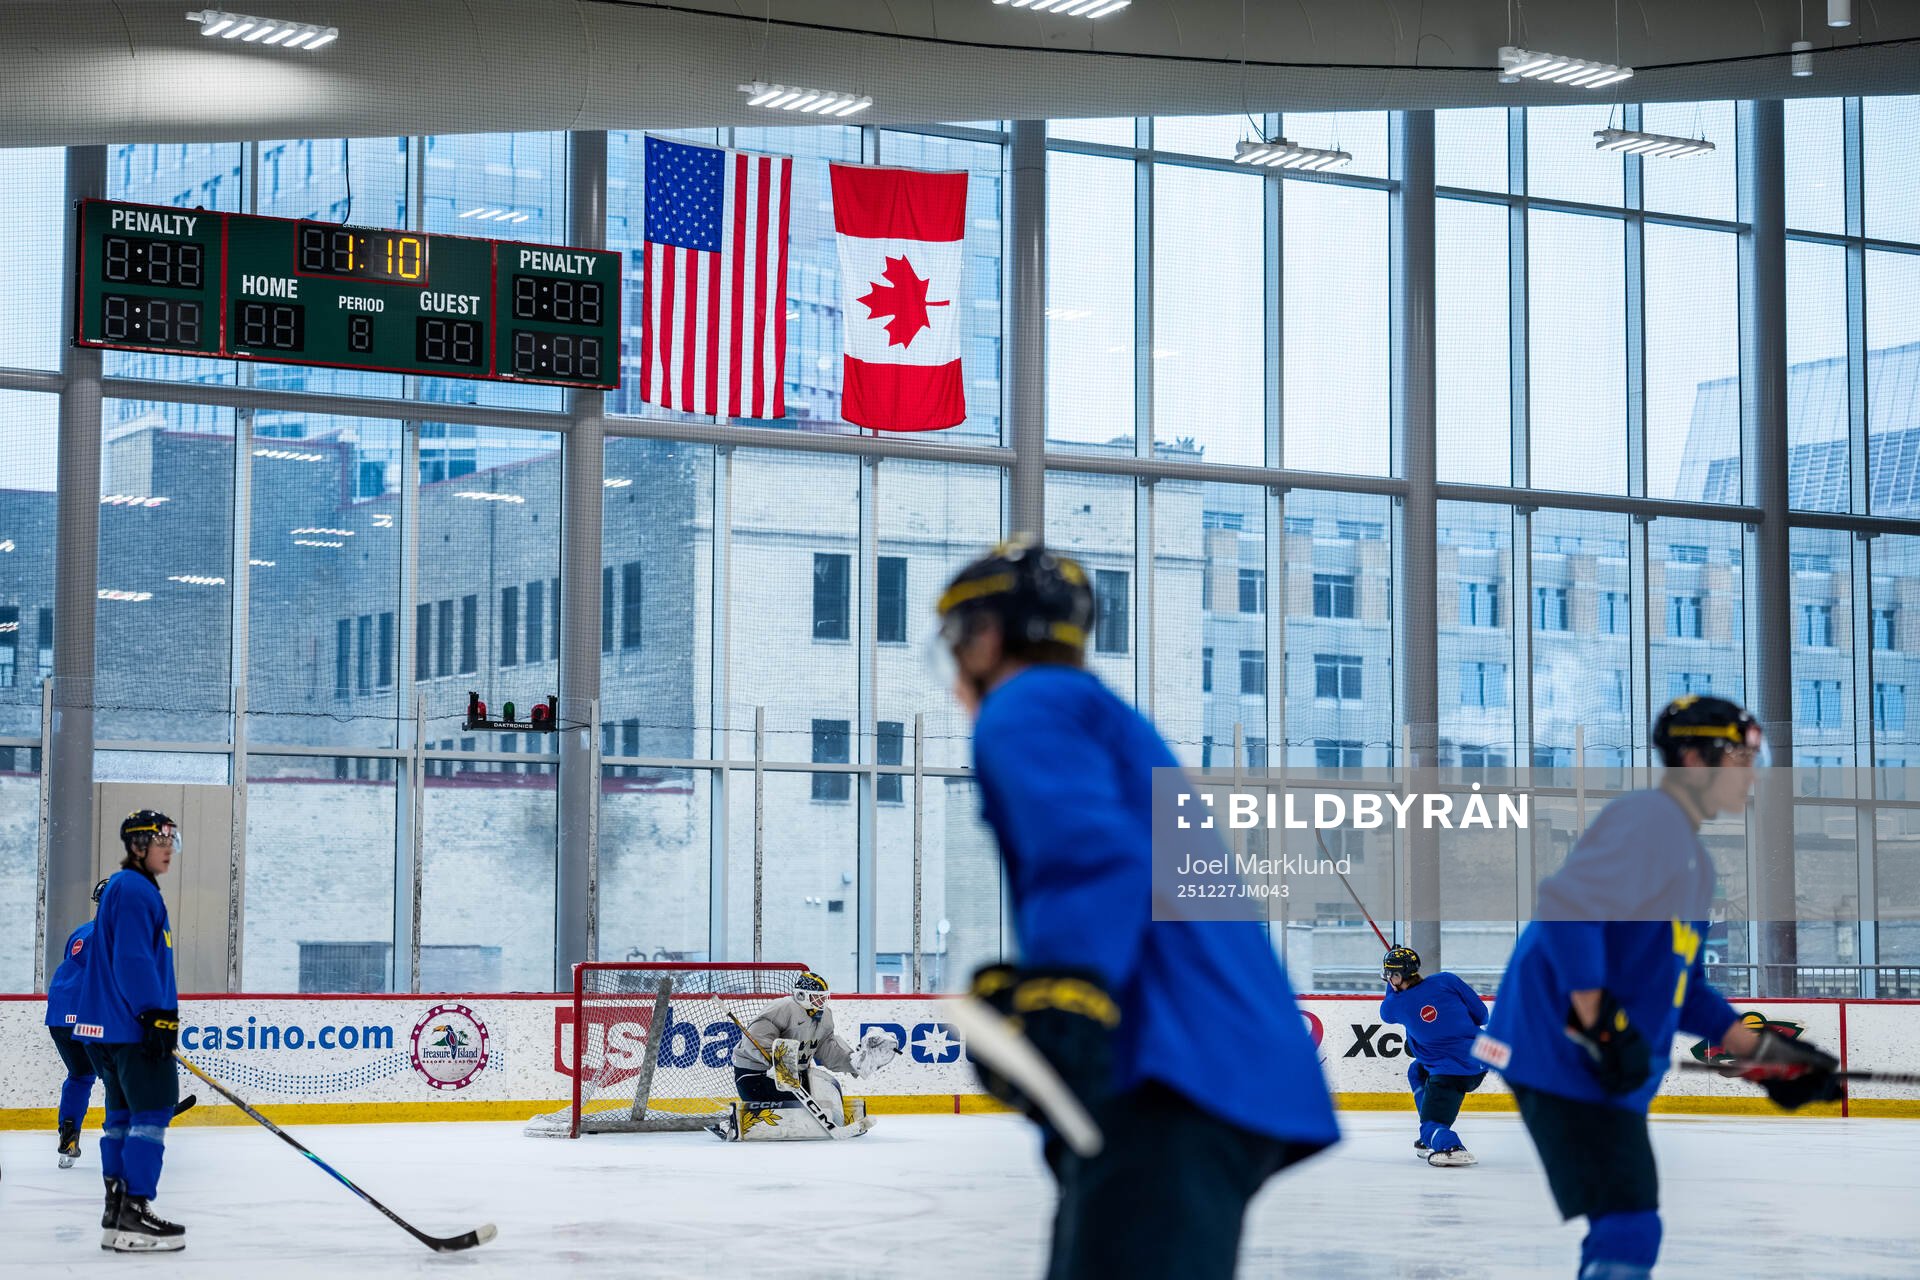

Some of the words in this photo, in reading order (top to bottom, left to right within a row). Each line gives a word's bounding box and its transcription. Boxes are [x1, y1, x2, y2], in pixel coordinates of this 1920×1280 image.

[112, 209, 197, 237] PENALTY
[348, 234, 420, 279] 1:10
[520, 250, 597, 276] PENALTY
[242, 275, 299, 300] HOME
[338, 296, 385, 313] PERIOD
[420, 292, 481, 316] GUEST
[154, 1019, 178, 1031] CC
[181, 1016, 394, 1050] casino.com
[422, 1047, 451, 1059] Treasure
[457, 1047, 478, 1059] Island
[750, 1101, 783, 1109] CCM
